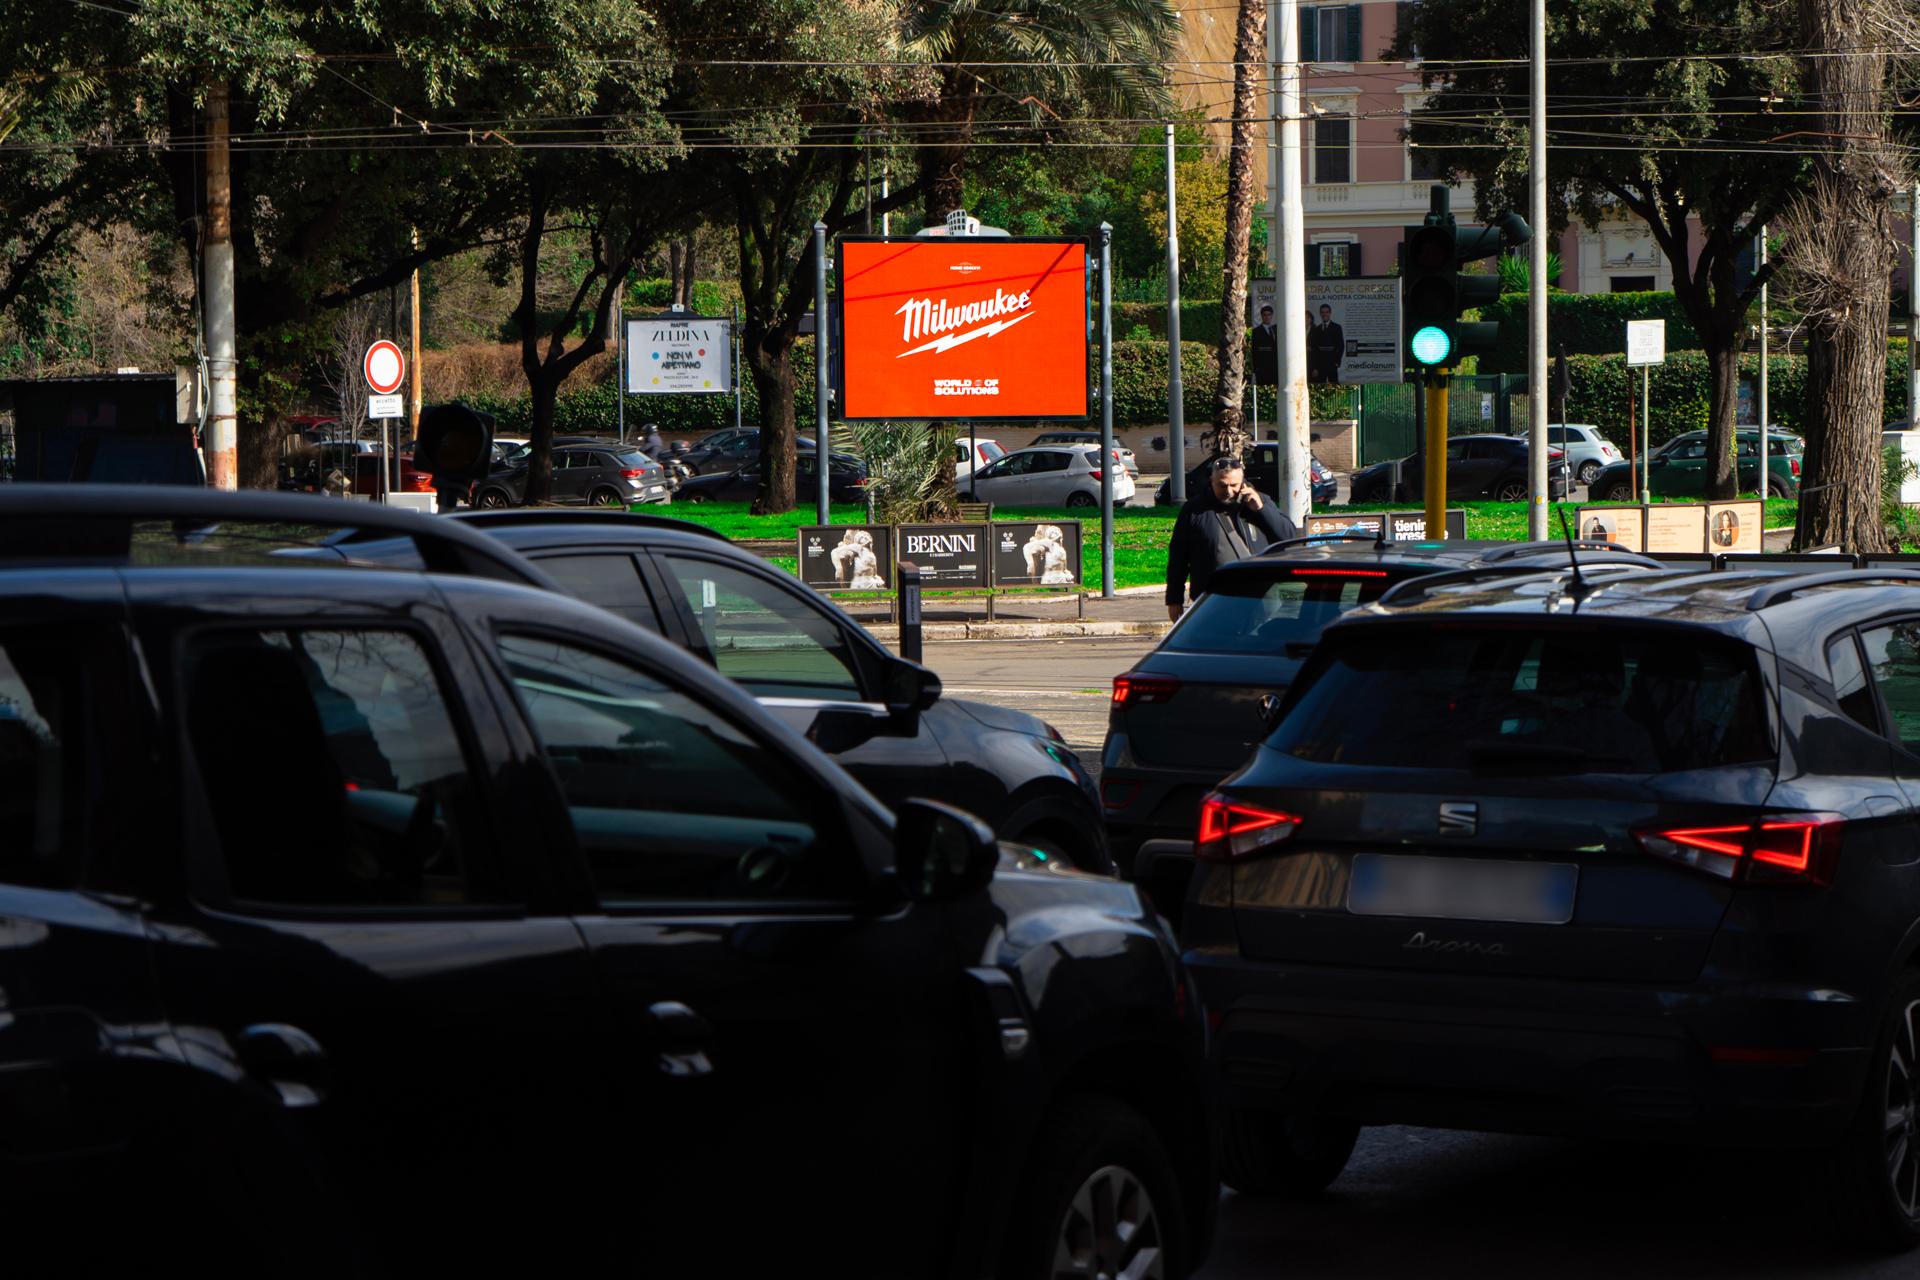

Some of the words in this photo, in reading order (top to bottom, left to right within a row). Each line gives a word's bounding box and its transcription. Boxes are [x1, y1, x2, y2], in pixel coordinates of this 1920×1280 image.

[1357, 283, 1395, 293] CRESCE
[895, 288, 1031, 343] Milwaukee
[666, 351, 684, 360] NON
[684, 351, 693, 359] VI
[1347, 361, 1396, 370] mediolanum
[934, 386, 1000, 395] SOLUTIONS
[906, 534, 976, 553] BERNINI
